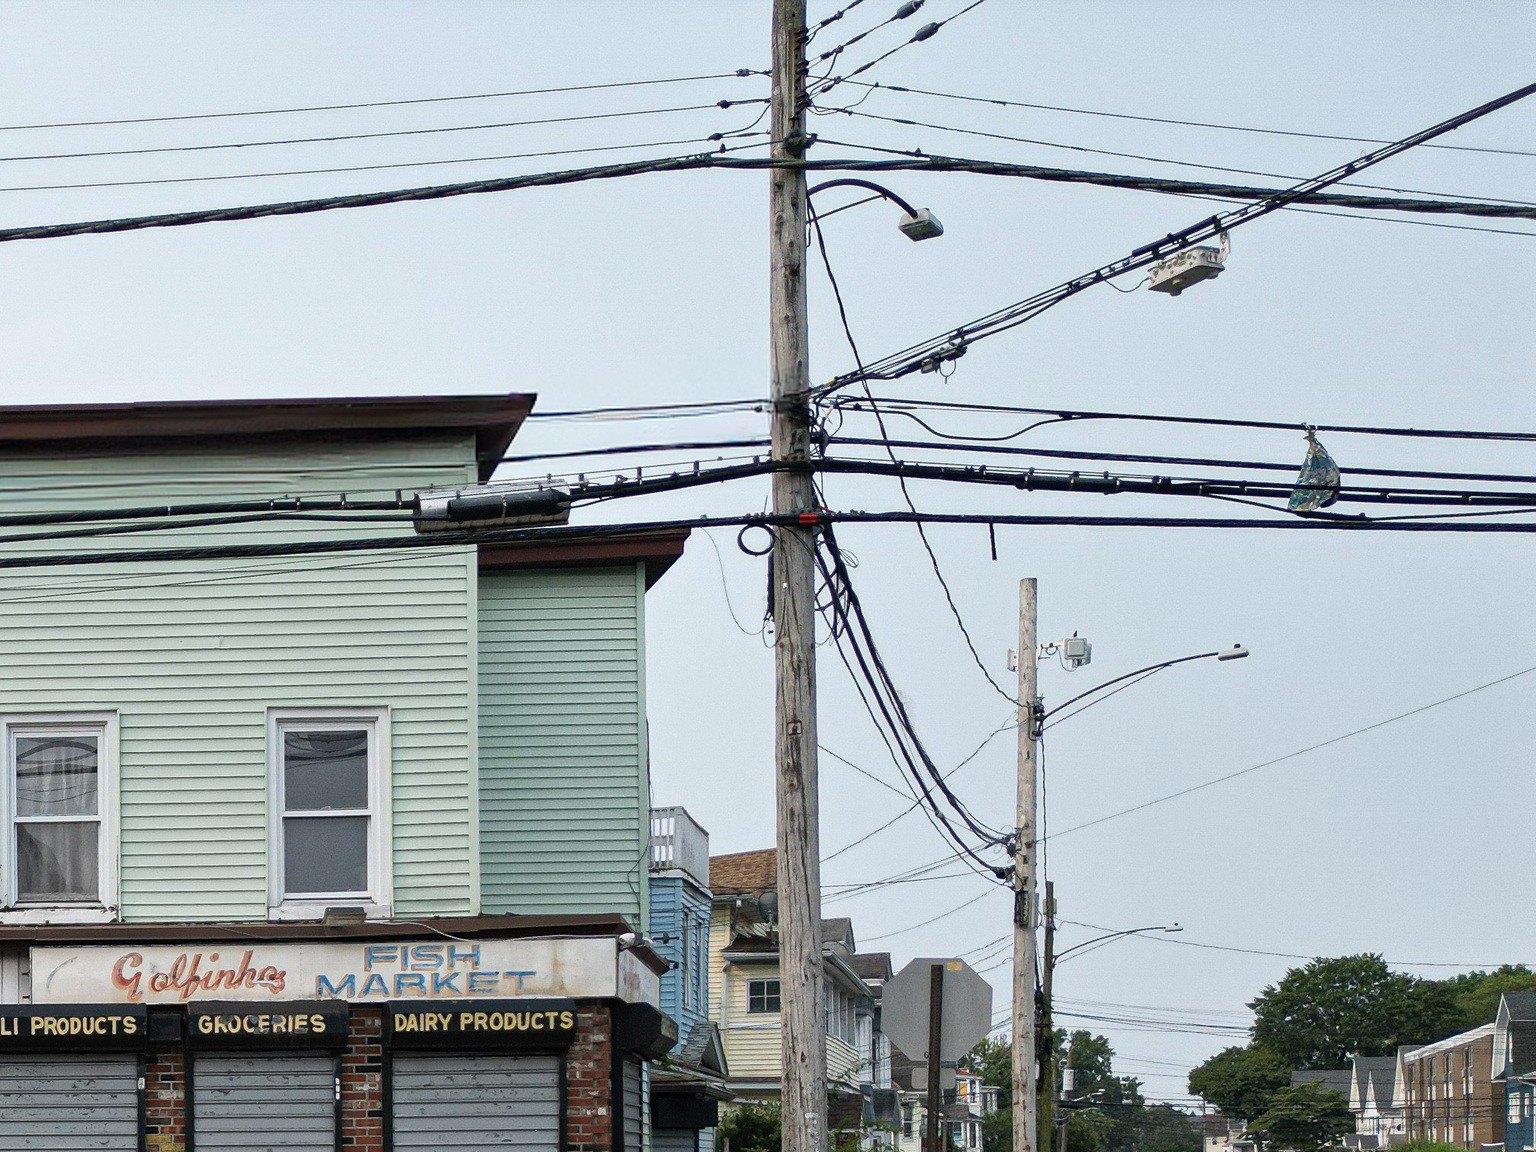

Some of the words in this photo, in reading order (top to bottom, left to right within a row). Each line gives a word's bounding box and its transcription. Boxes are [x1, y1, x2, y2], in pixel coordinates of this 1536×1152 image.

[363, 944, 481, 972] FISH
[315, 970, 538, 999] MARKET
[30, 1015, 138, 1036] PRODUCTS
[197, 1013, 327, 1035] GROCERIES
[394, 1013, 453, 1032] DAIRY
[460, 1011, 575, 1031] PRODUCTS
